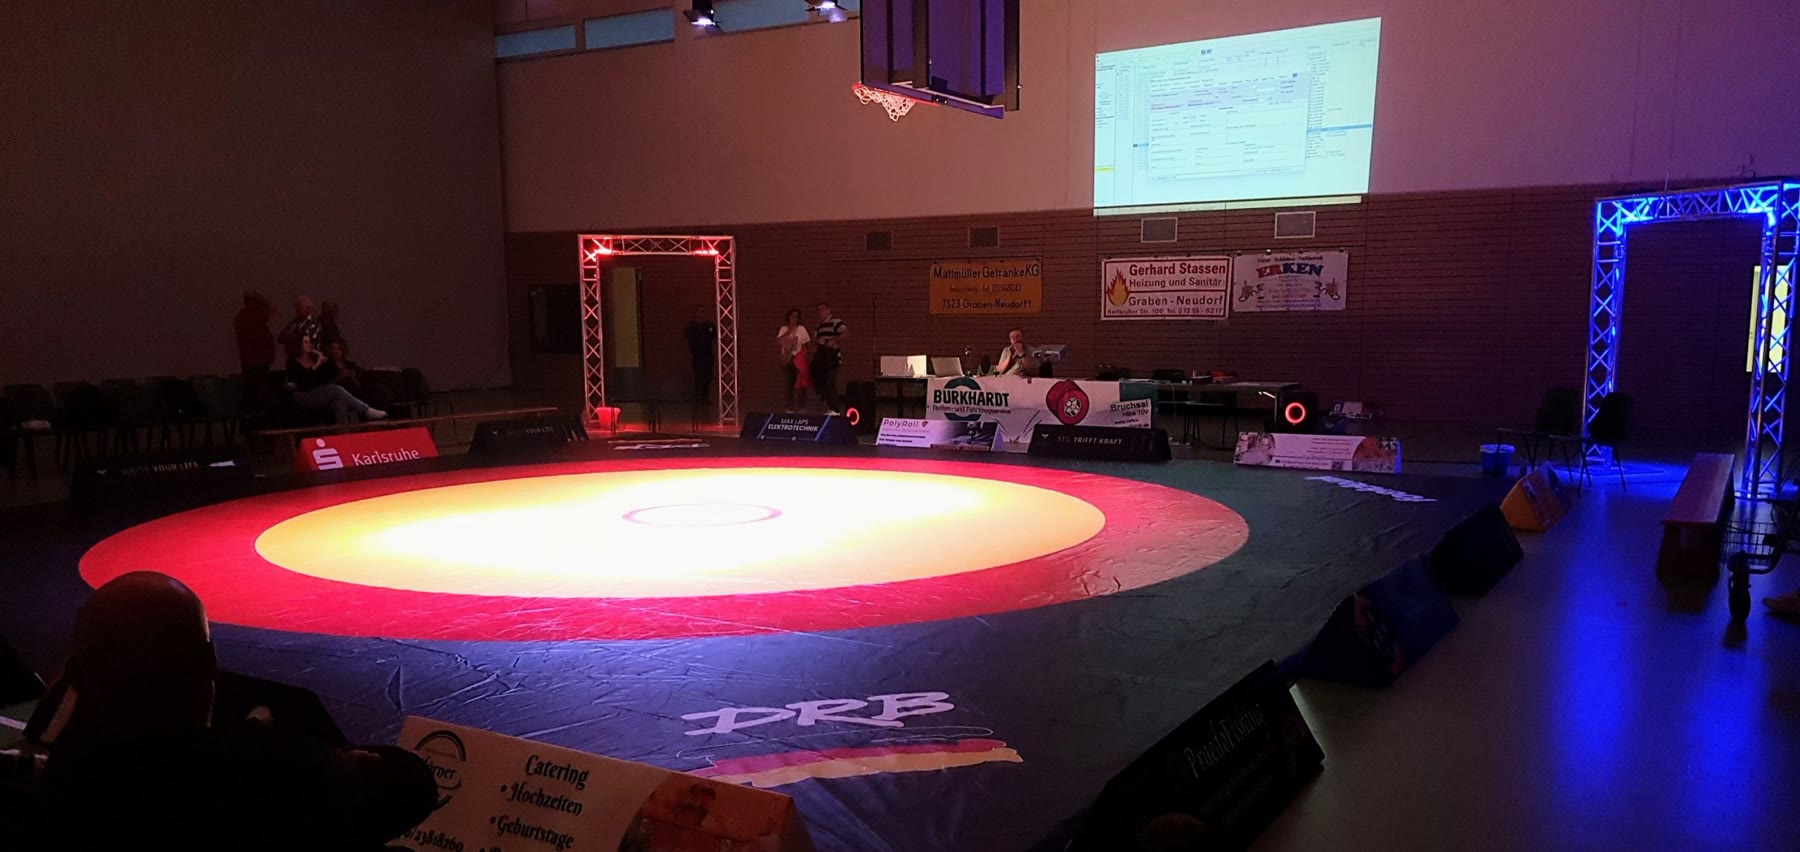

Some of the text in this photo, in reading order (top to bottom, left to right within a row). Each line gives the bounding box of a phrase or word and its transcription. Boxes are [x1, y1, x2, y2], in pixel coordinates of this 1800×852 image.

[1129, 262, 1226, 276] Gerhard Stassen
[1256, 262, 1324, 278] ERKEN
[1129, 277, 1222, 288] Heizung und Sanitär
[1128, 296, 1168, 306] Graben
[1176, 295, 1223, 305] Neudorf
[933, 389, 1010, 407] BURKHARDT
[1110, 400, 1149, 412] Bruchsal
[768, 424, 819, 432] ELEKTROTECHNIK
[883, 419, 919, 428] PolyRoll
[351, 448, 420, 466] Karlsruhe
[681, 691, 955, 735] DRB
[525, 754, 589, 790] Catering
[507, 782, 583, 816] Hochzeiten
[497, 814, 574, 851] Geburtstage
